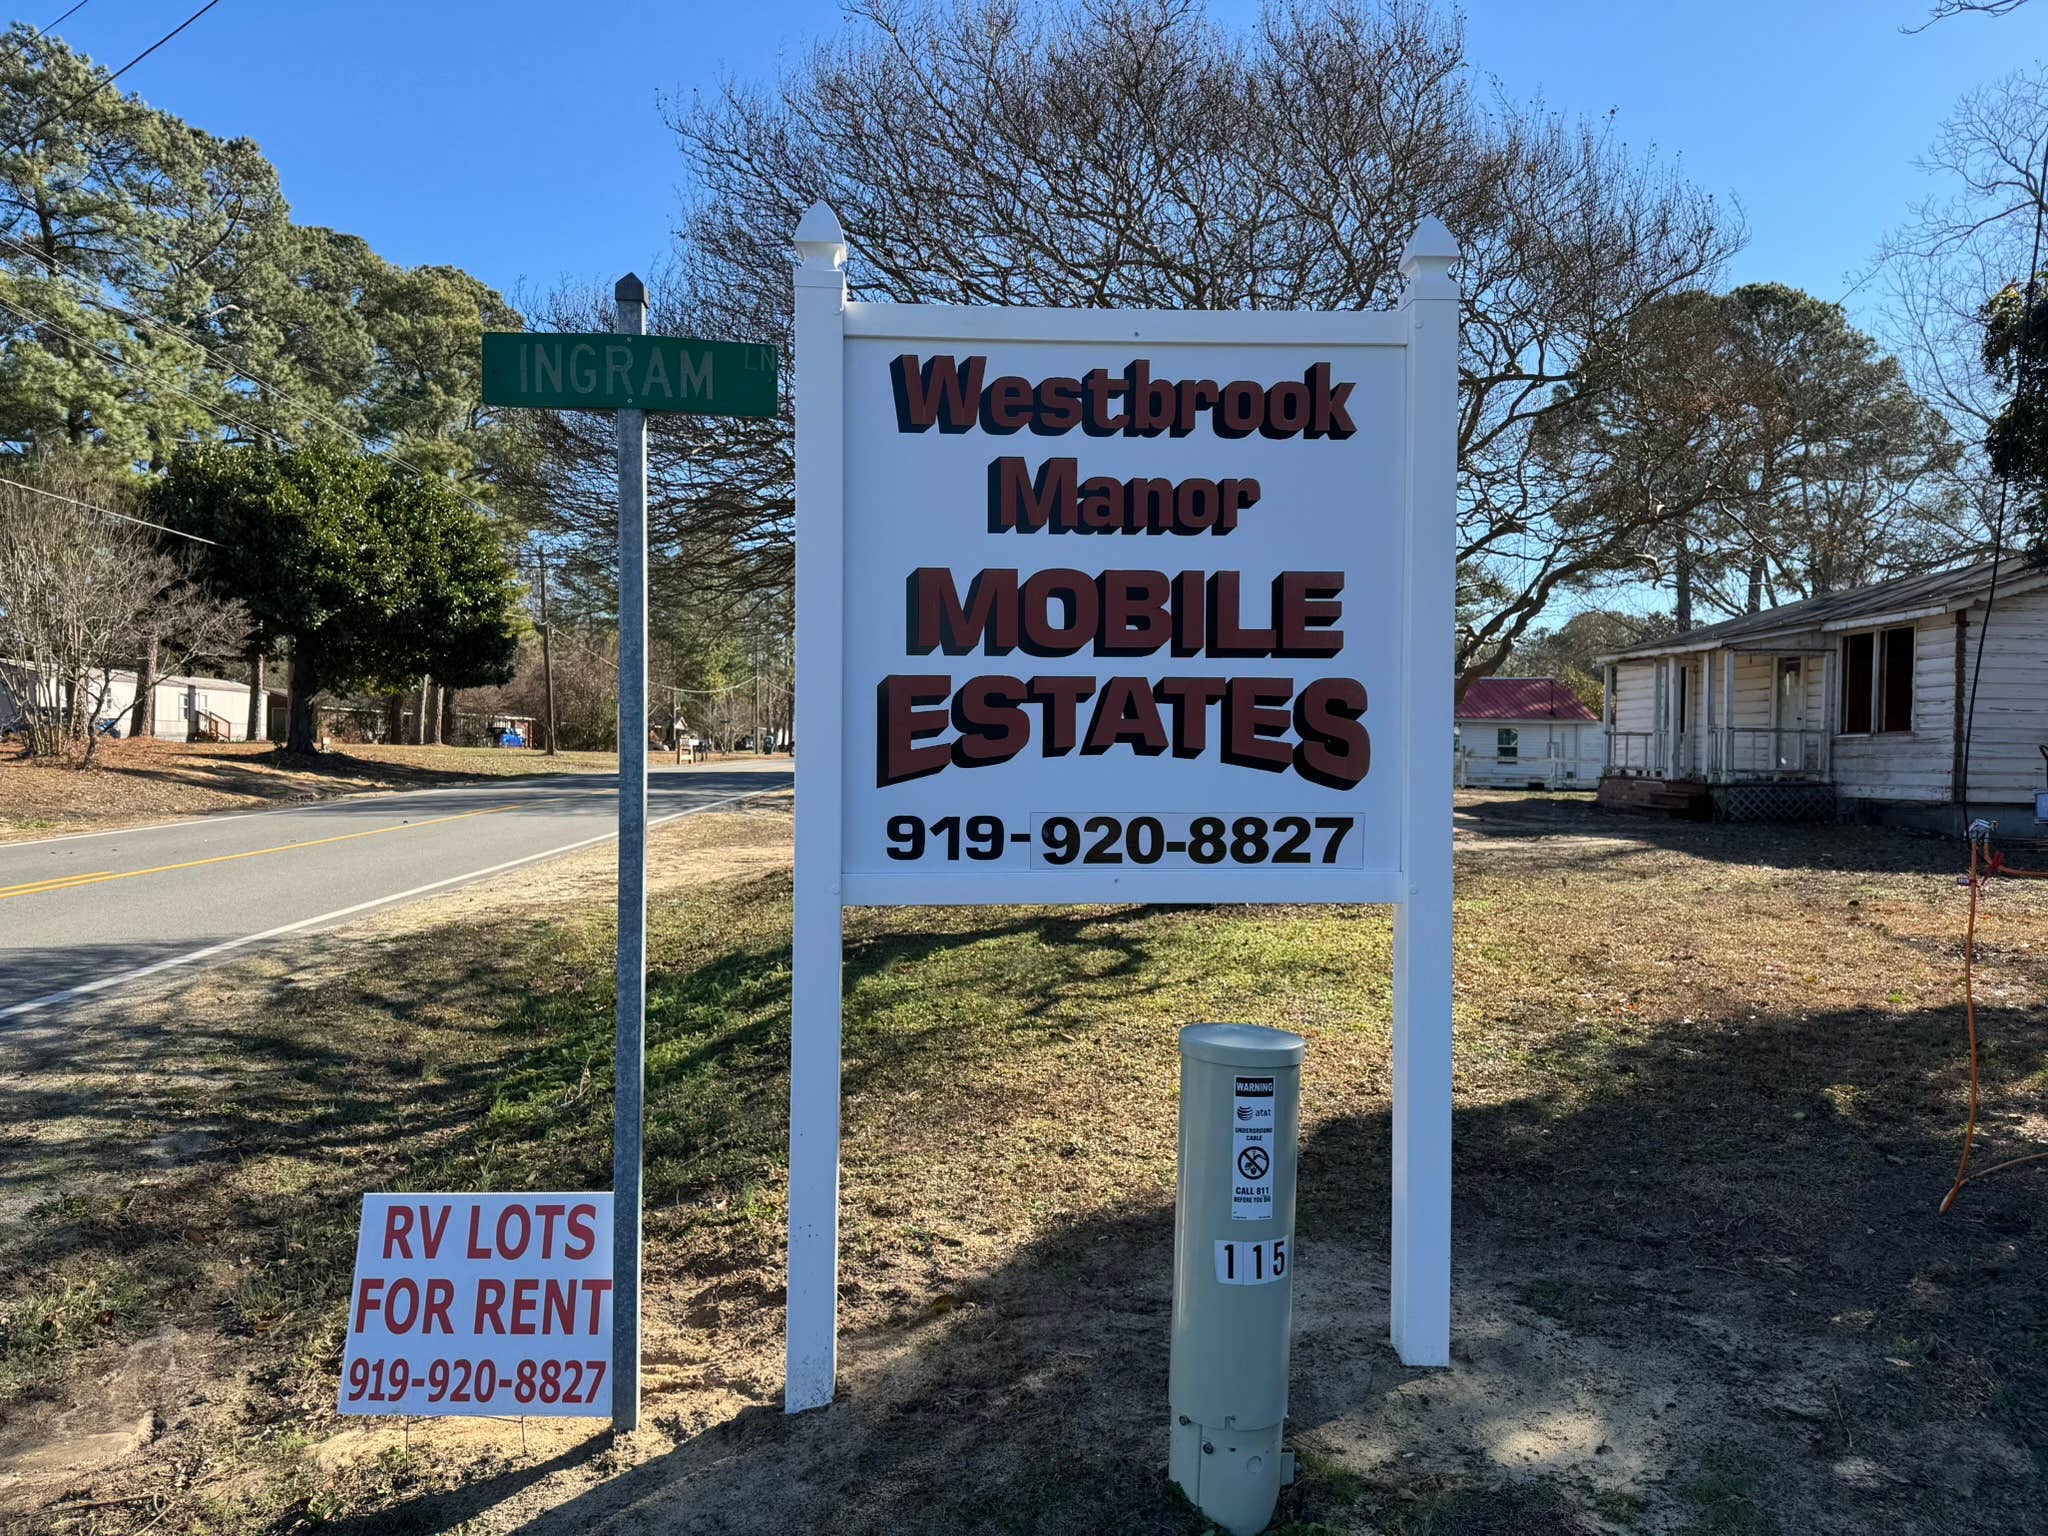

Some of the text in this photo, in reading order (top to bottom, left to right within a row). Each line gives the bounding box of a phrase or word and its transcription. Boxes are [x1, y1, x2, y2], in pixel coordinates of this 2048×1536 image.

[519, 343, 776, 400] INGRAM LN
[889, 354, 1357, 440] Westbrook
[987, 456, 1261, 536] Manor
[906, 567, 1345, 658] MOBILE
[876, 674, 1371, 791] ESTATES
[886, 815, 1354, 865] 919-920-8827
[1236, 1082, 1273, 1092] WARNING
[1235, 1186, 1270, 1195] CALL 811
[382, 1204, 597, 1261] RV LOTS
[1224, 1240, 1285, 1280] 115
[354, 1277, 613, 1335] FOR RENT
[347, 1357, 607, 1404] 919-920-8827
